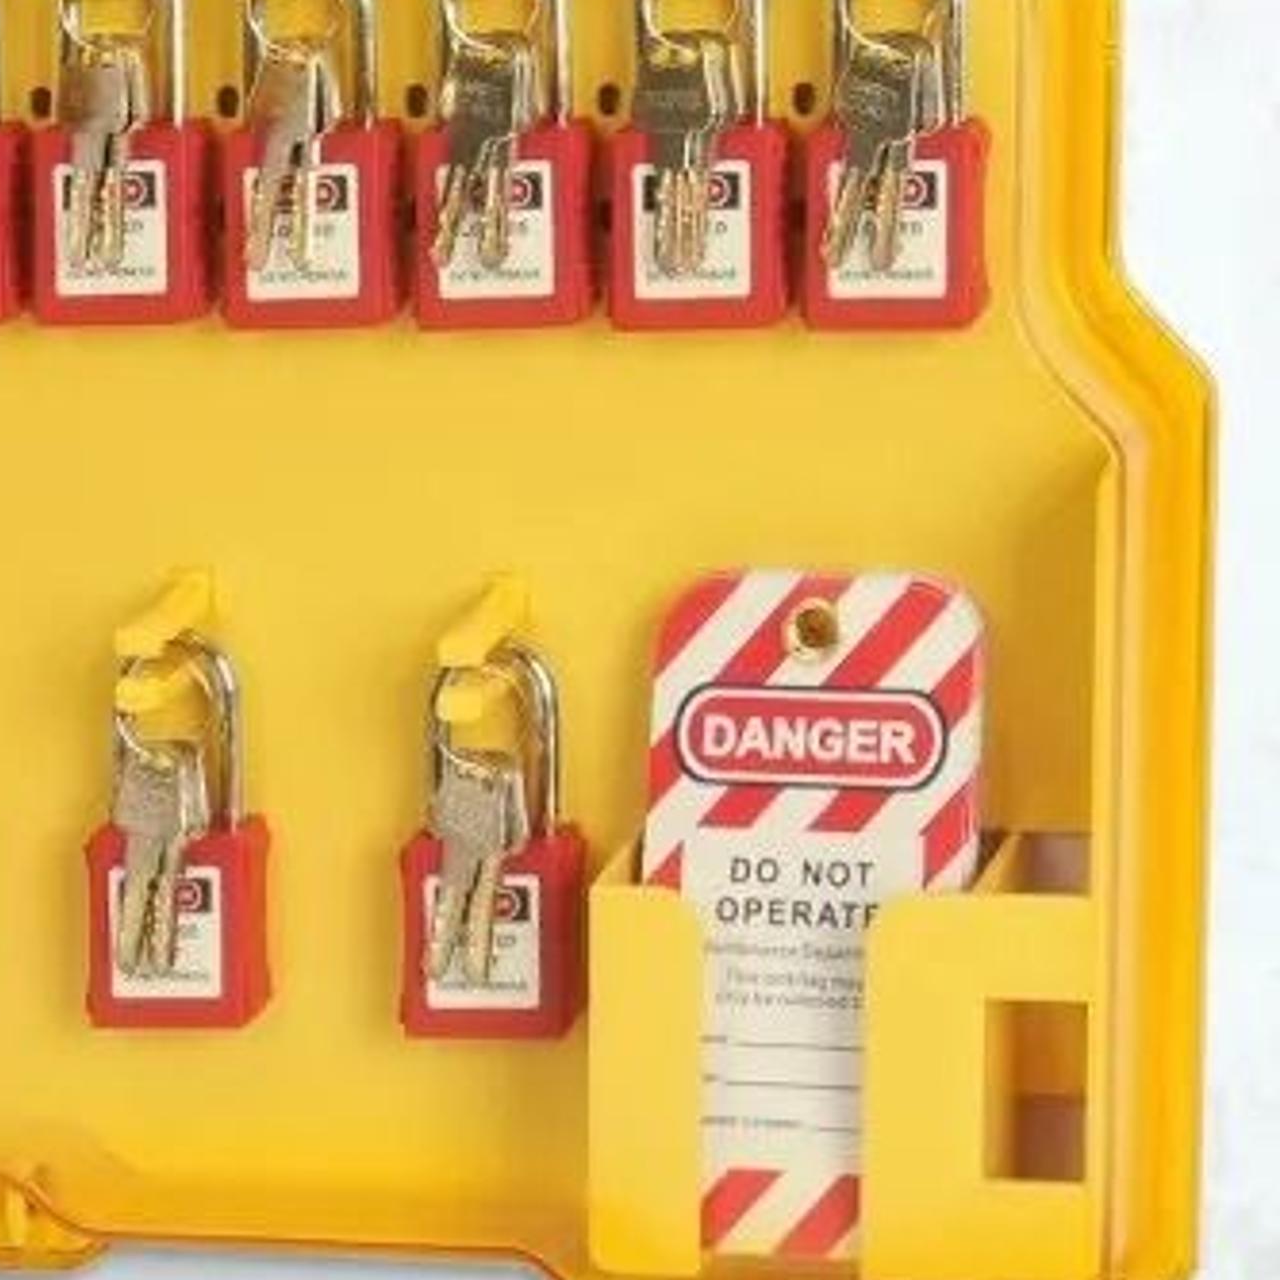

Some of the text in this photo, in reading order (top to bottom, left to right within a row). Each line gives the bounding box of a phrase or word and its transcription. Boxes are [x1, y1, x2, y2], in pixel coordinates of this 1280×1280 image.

[701, 712, 917, 765] DANGER
[729, 856, 875, 889] DO NOT
